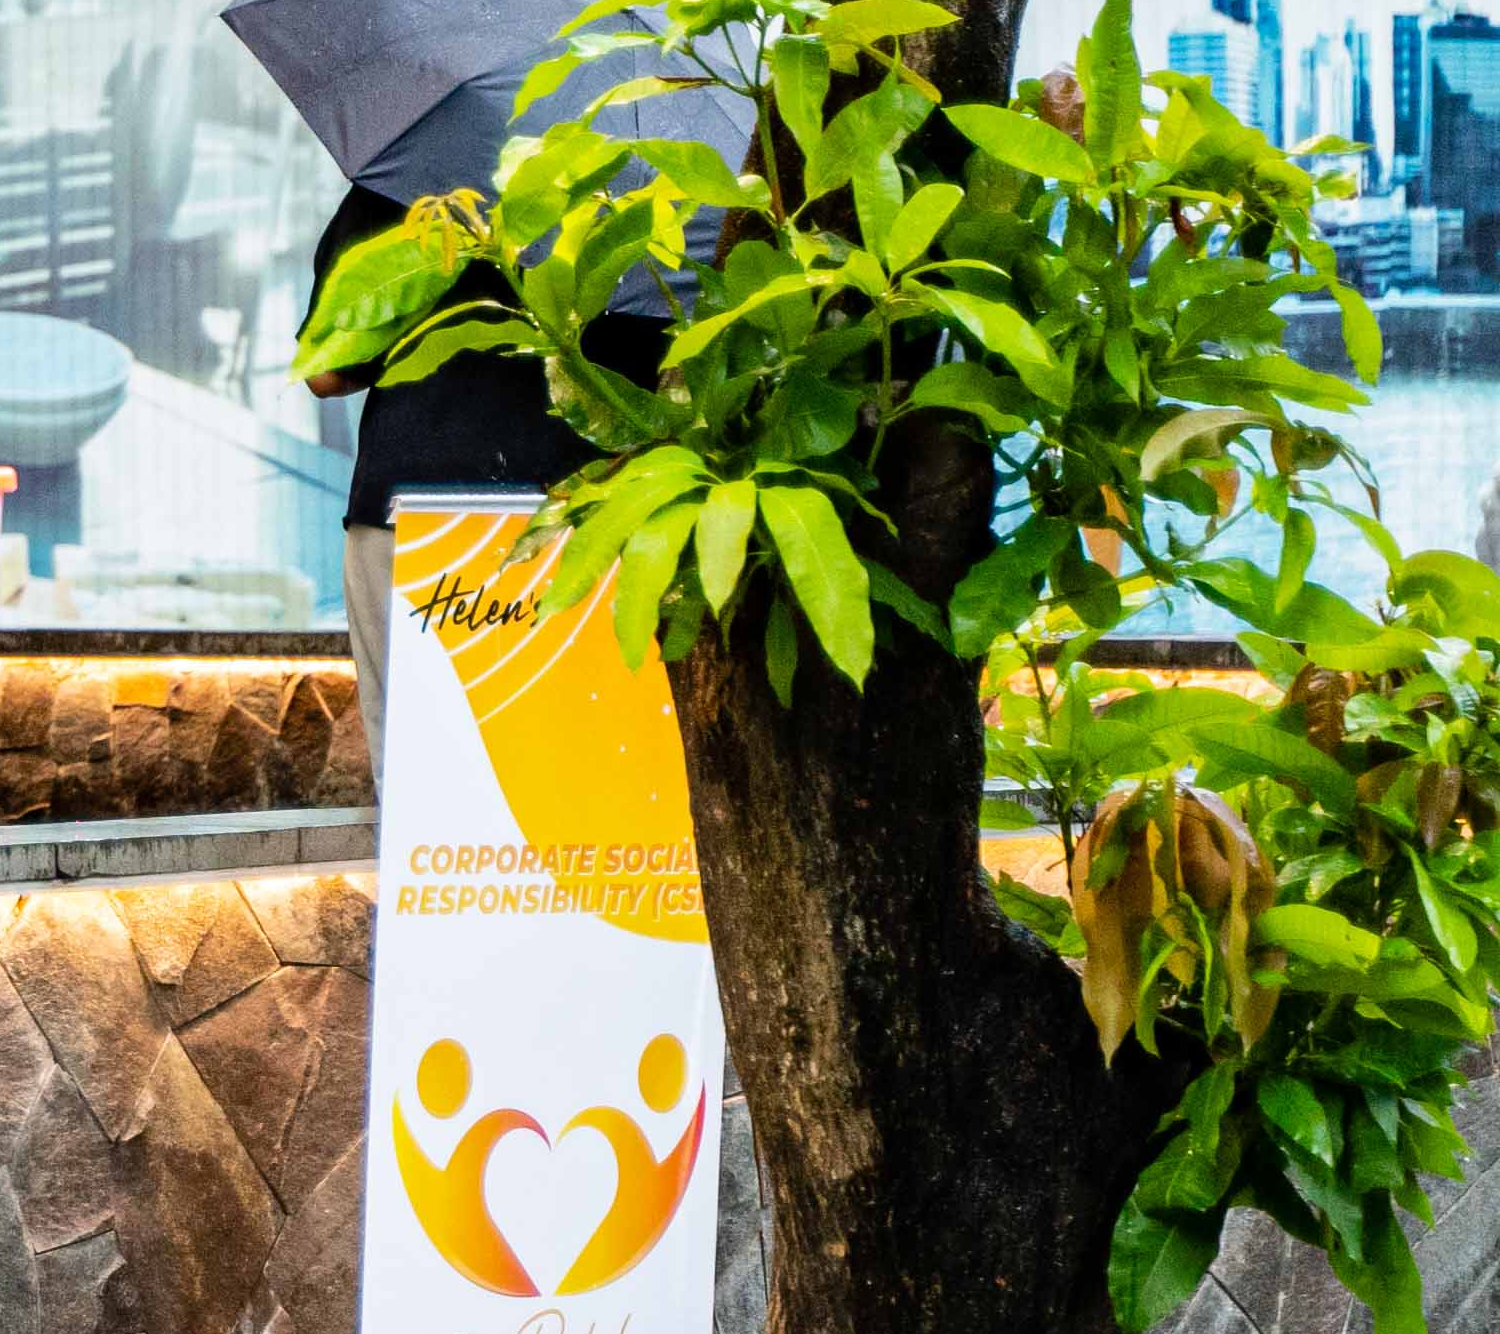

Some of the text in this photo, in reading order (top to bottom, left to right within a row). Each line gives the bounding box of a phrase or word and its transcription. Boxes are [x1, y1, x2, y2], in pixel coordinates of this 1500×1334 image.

[410, 841, 700, 876] CORPORATE SOCIA
[396, 882, 649, 916] RESPONSIBILITY
